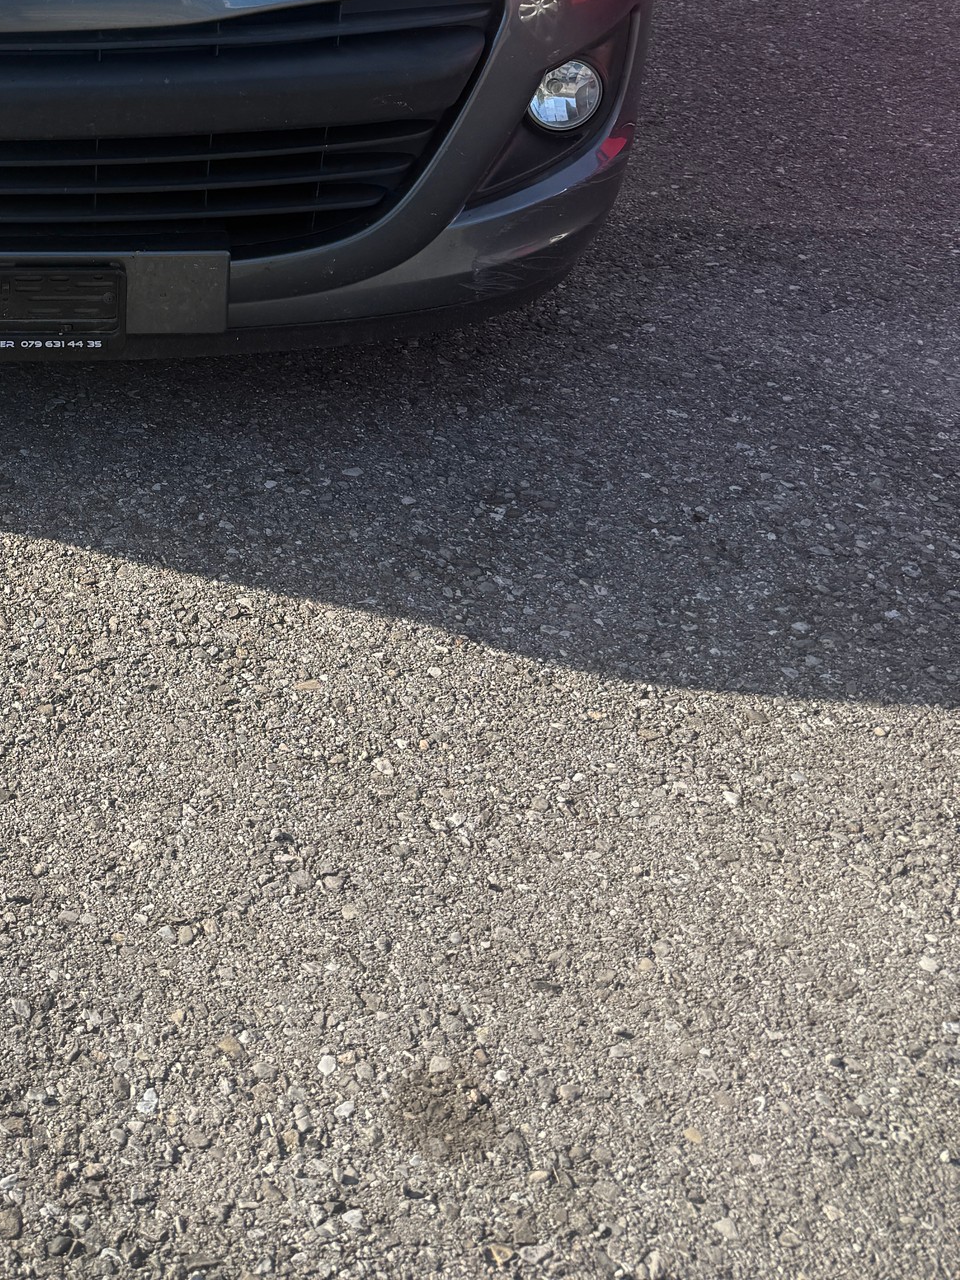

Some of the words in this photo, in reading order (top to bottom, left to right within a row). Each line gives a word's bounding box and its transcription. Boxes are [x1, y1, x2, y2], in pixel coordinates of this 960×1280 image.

[20, 340, 43, 348] 079
[44, 340, 65, 348] 631
[67, 340, 84, 348] 44
[86, 340, 102, 348] 35
